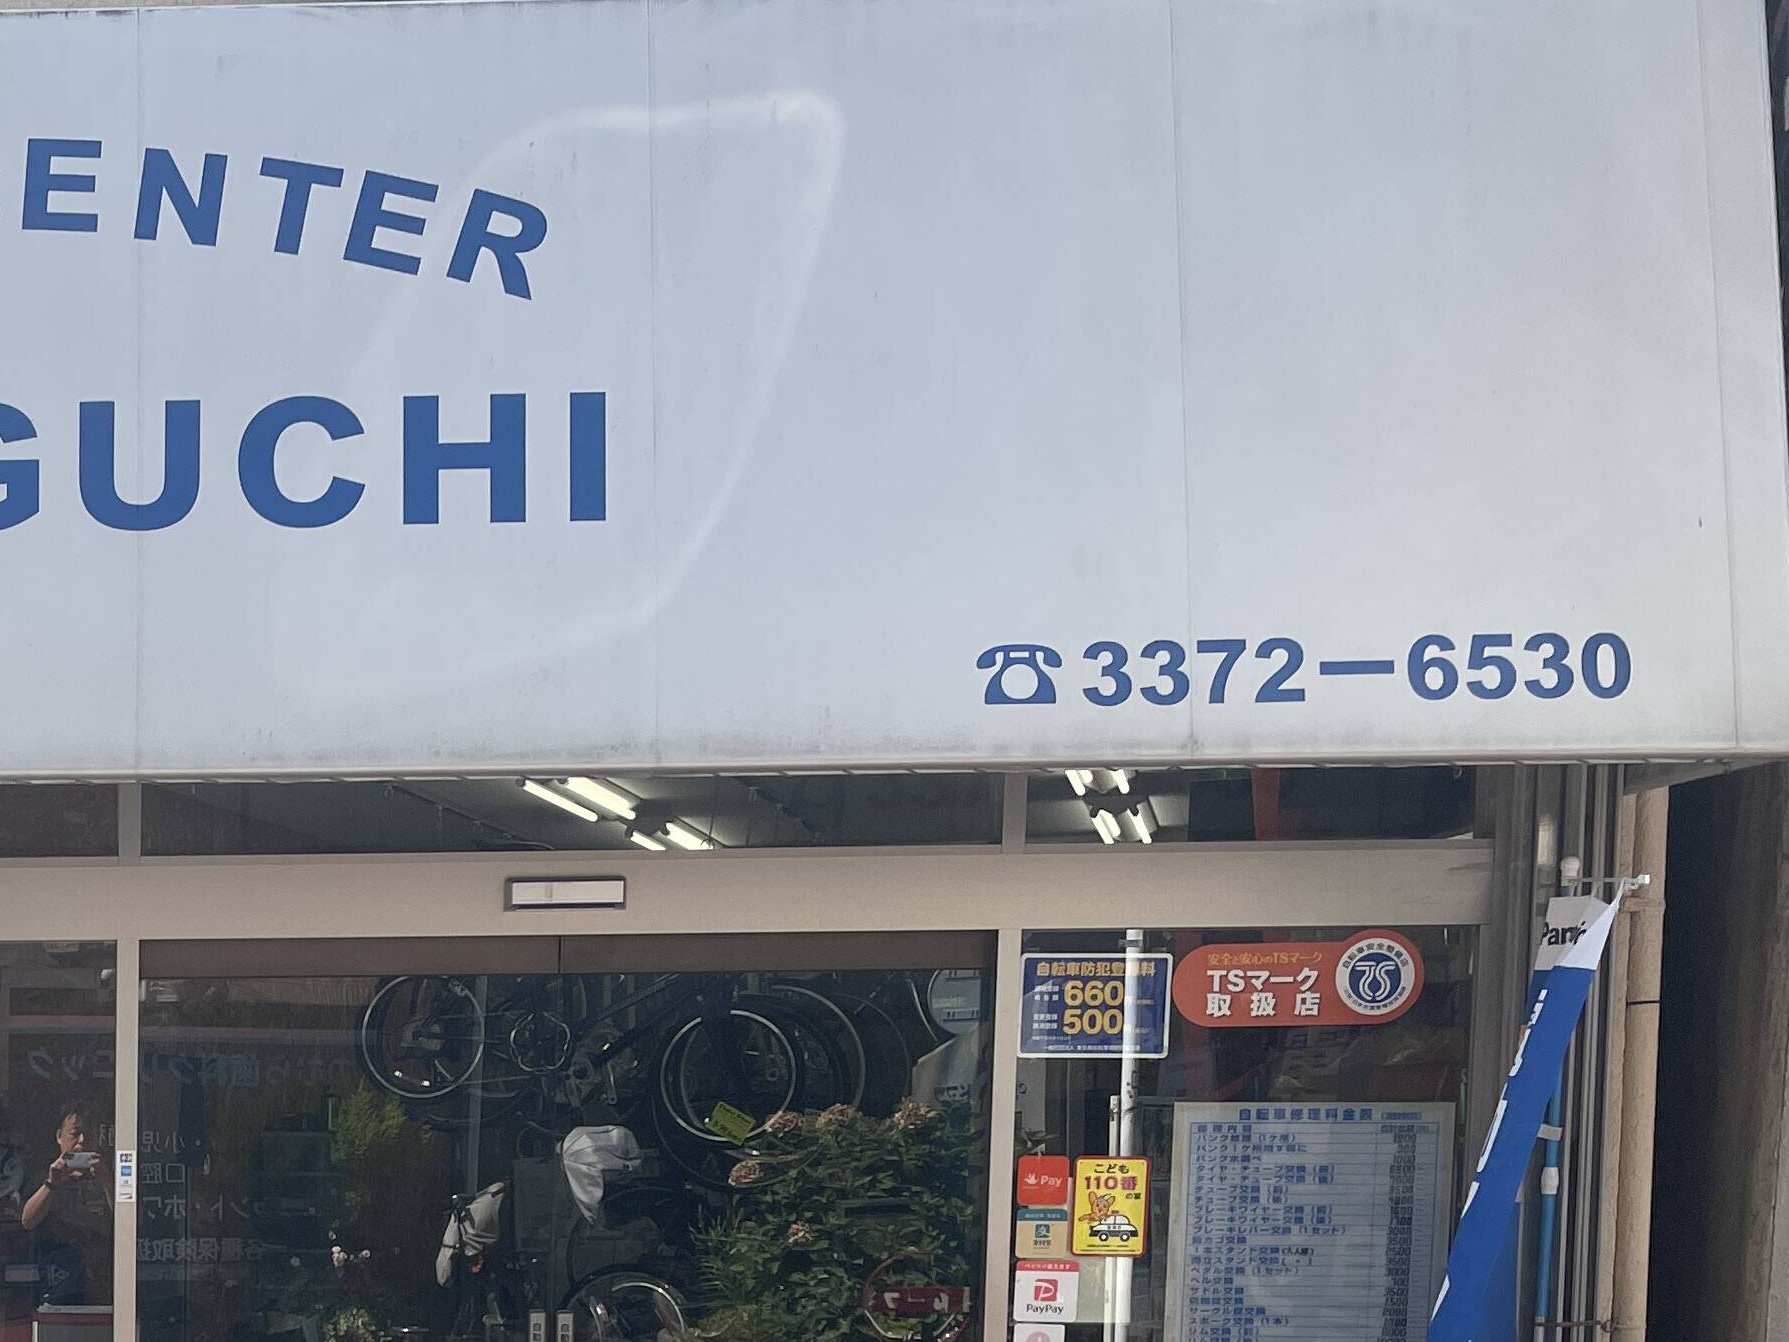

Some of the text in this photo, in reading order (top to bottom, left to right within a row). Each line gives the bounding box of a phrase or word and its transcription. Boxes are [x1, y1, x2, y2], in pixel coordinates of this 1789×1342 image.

[1207, 951, 1324, 966] 安全と安心のTSマーク
[1205, 966, 1320, 993] TSマーク
[1064, 980, 1124, 1007] 660
[1063, 1008, 1123, 1035] 500
[1093, 1163, 1130, 1174] こども
[1040, 1175, 1063, 1188] Pay
[1084, 1176, 1138, 1191] 110番
[1026, 1303, 1064, 1315] PayPay
